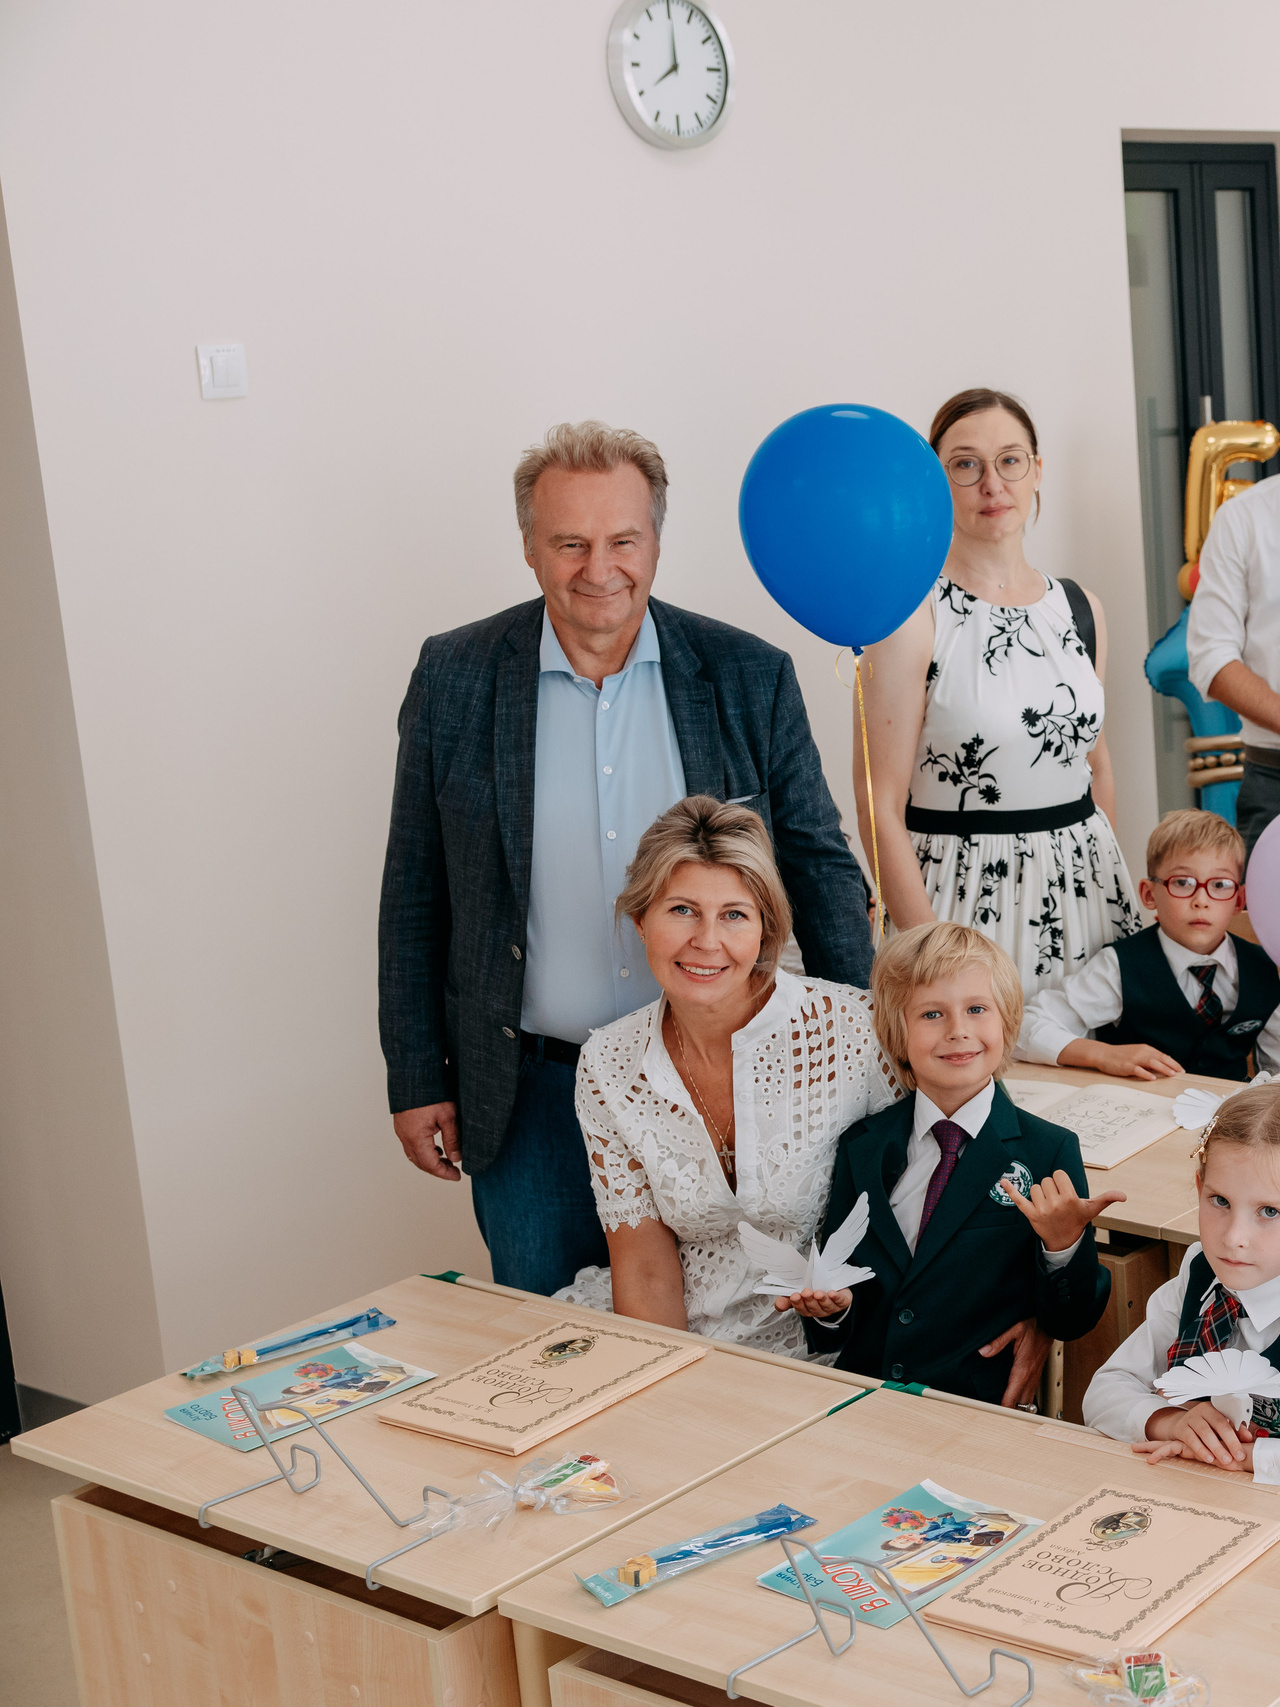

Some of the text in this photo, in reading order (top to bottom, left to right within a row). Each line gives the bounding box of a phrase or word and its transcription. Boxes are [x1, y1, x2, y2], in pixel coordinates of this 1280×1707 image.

[486, 1368, 545, 1386] СЛОВО
[233, 1430, 258, 1440] В
[1036, 1551, 1113, 1575] СЛОВО
[785, 1566, 824, 1588] Баро
[987, 1587, 1039, 1605] Ушинский
[860, 1598, 891, 1613] В
